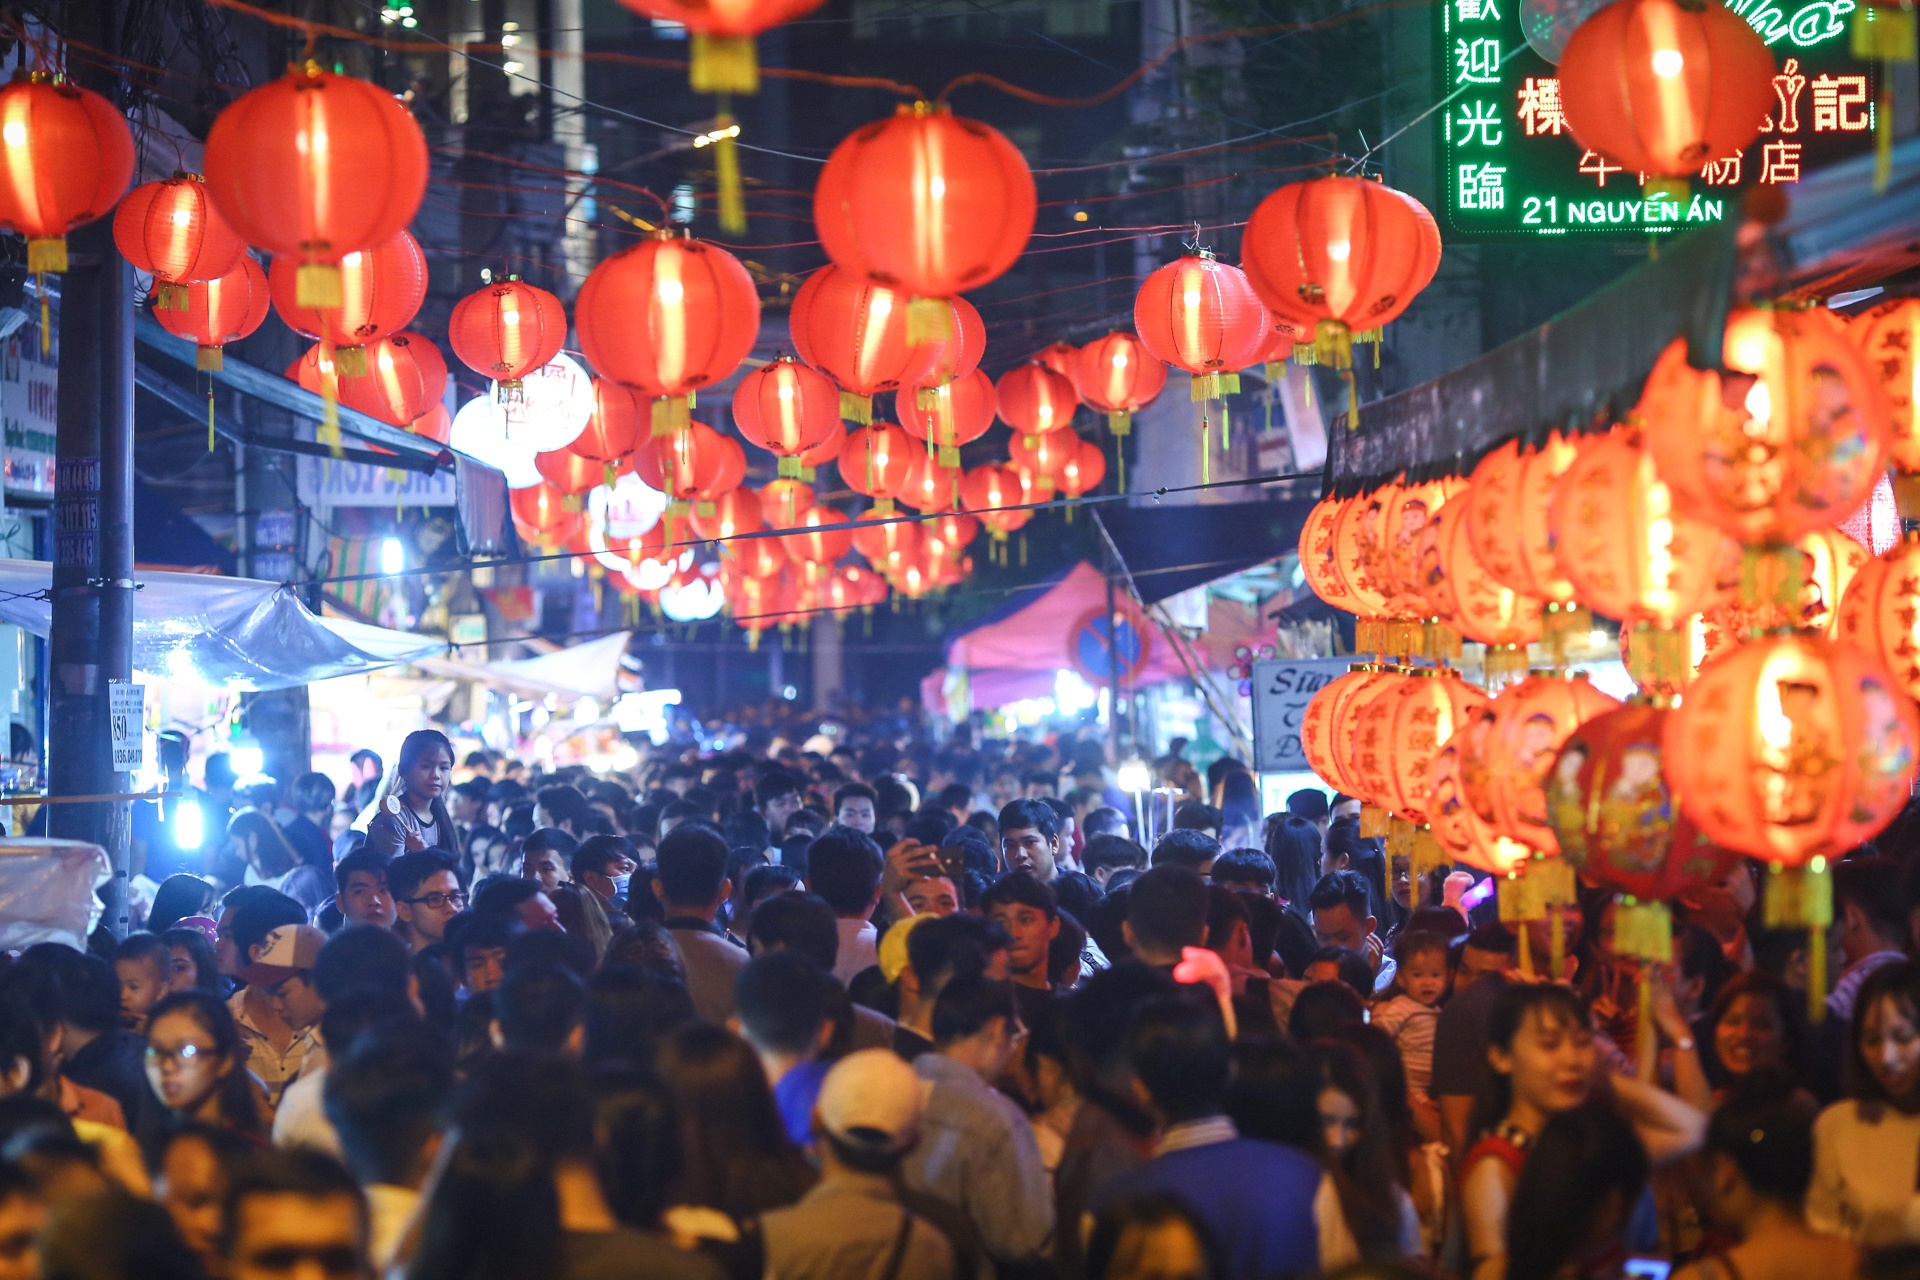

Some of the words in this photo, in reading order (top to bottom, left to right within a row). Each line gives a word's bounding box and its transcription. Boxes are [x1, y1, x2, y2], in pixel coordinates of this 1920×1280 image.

[1811, 73, 1868, 131] 記
[1522, 196, 1557, 224] 21
[1686, 194, 1723, 222] ÁN
[112, 715, 127, 741] 850
